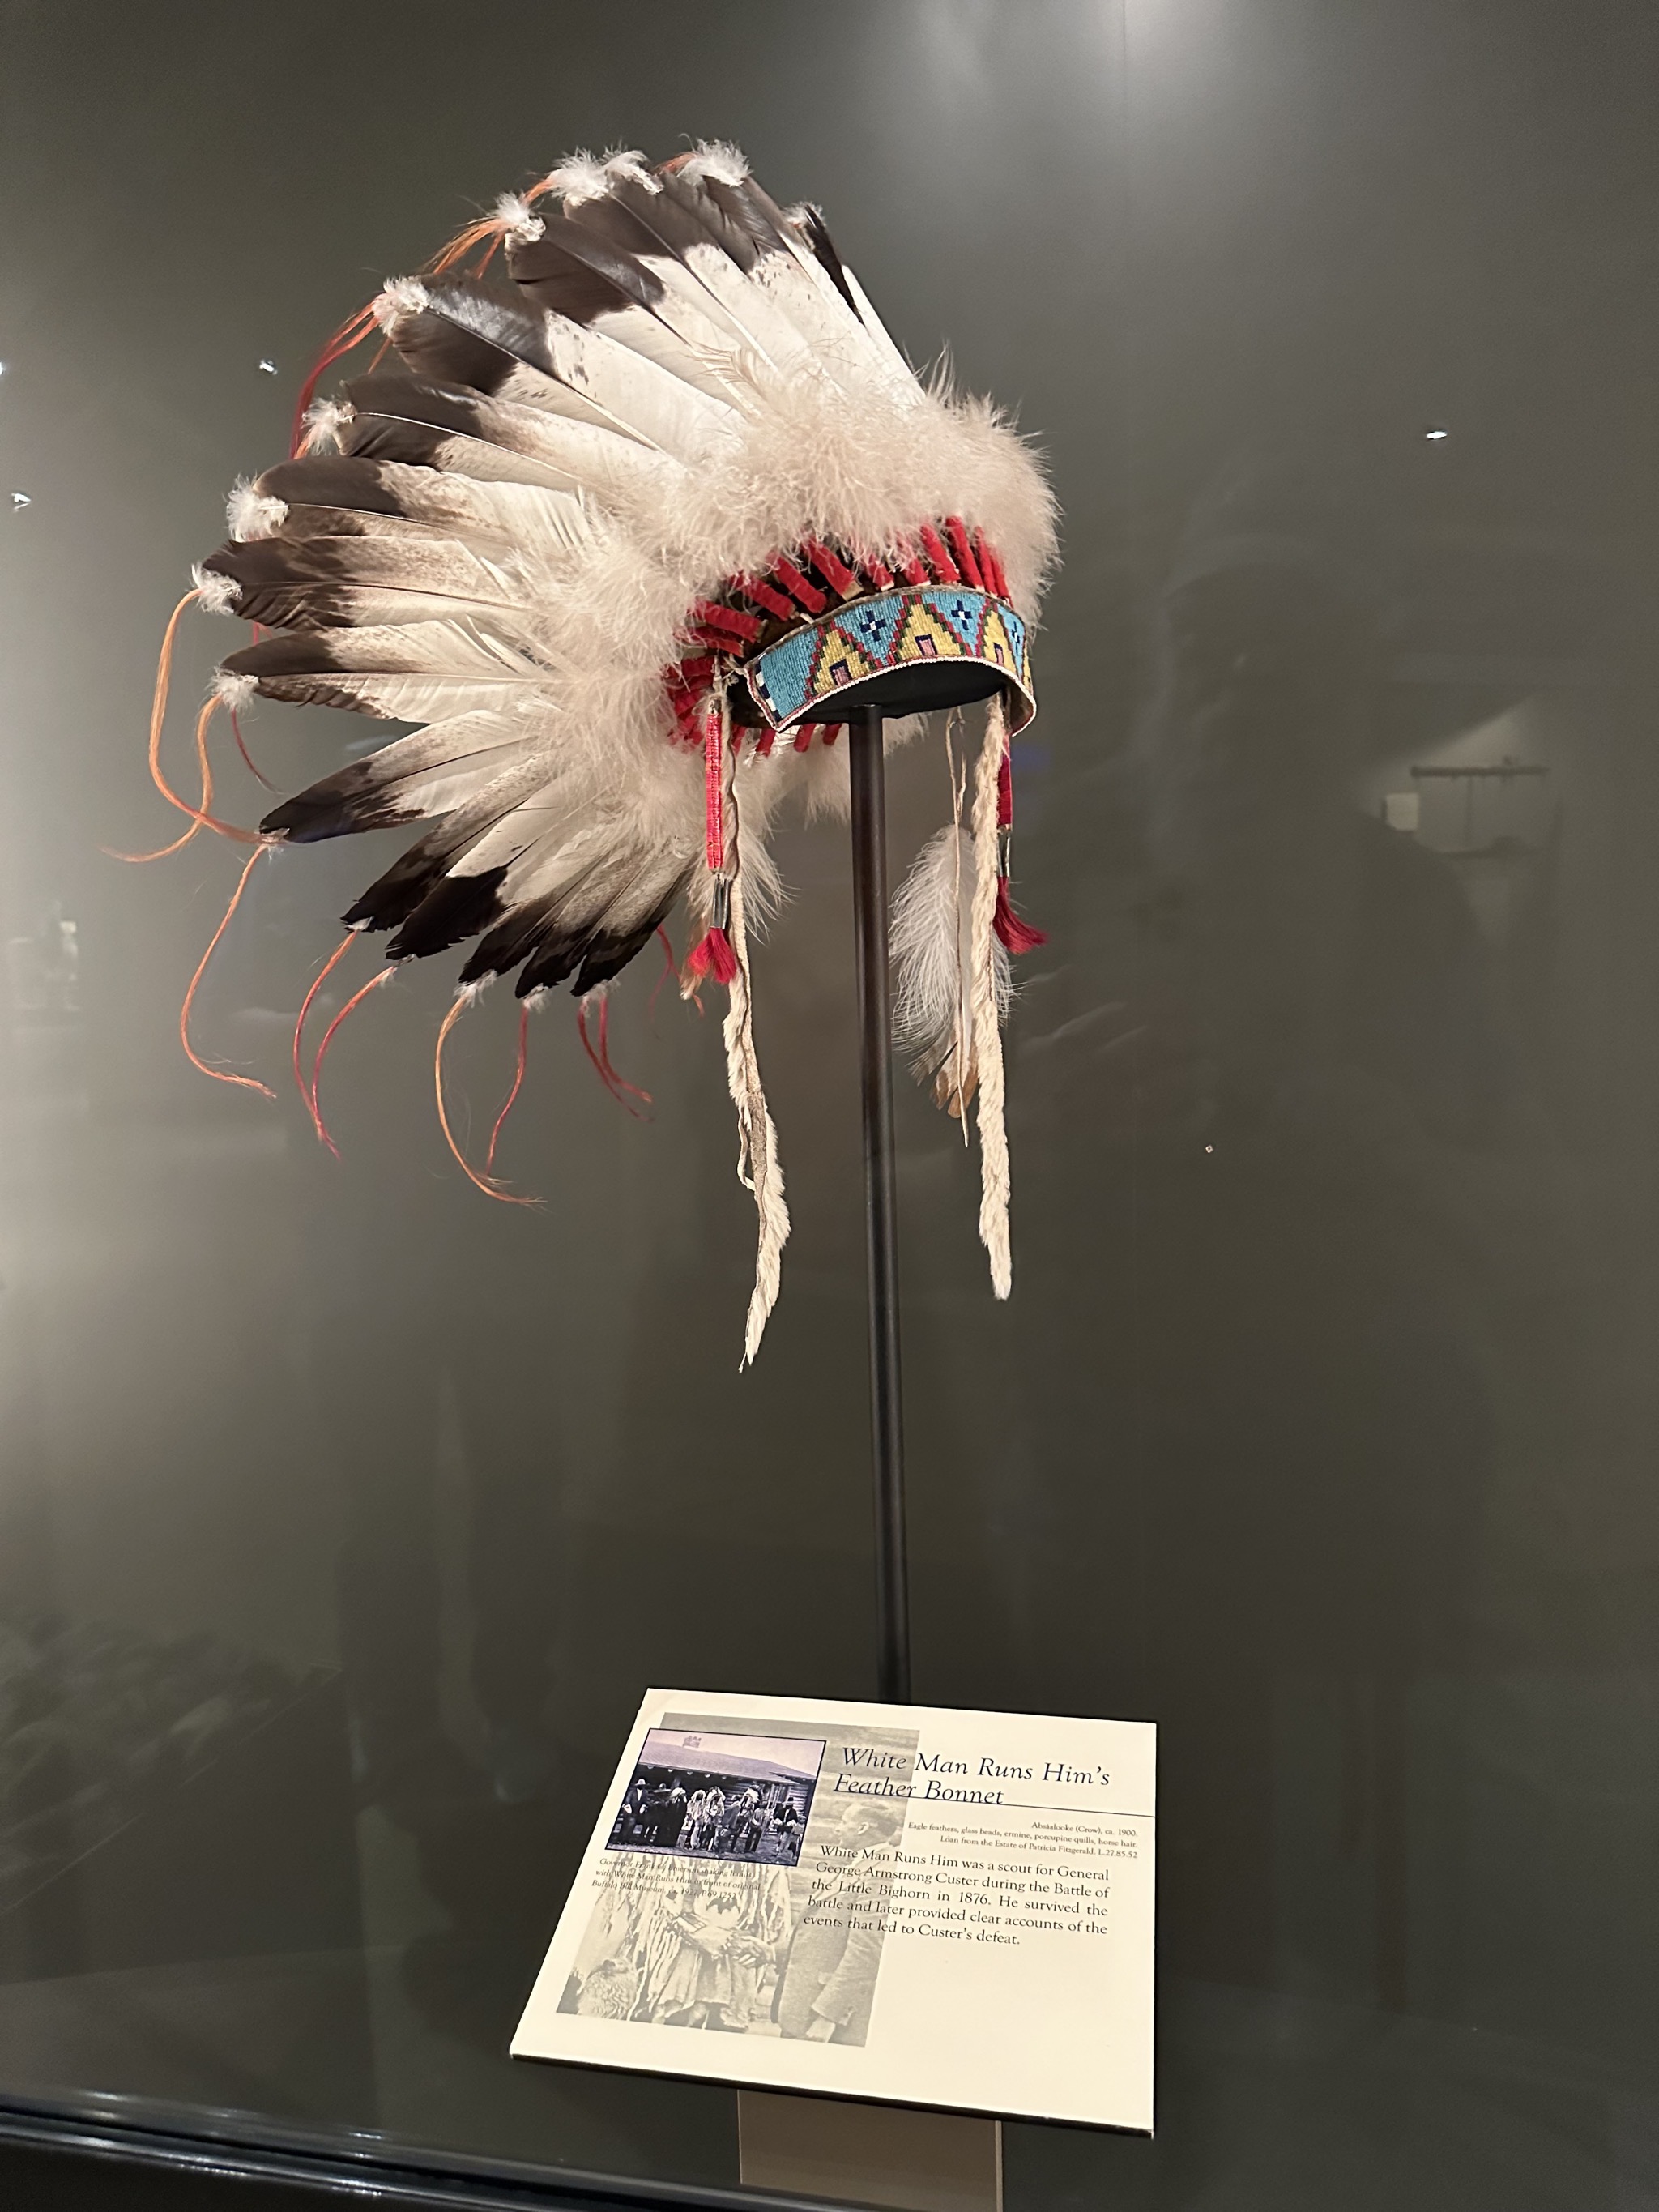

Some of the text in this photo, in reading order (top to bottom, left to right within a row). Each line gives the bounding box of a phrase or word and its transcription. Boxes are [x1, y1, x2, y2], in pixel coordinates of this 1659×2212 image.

[842, 1747, 1110, 1786] White Man Runs Him's
[834, 1773, 1004, 1804] Feather Bonnet
[908, 1821, 928, 1830] Eagle
[929, 1823, 959, 1834] feathers,
[961, 1826, 978, 1834] glass
[979, 1828, 1002, 1837] beads,
[1034, 1834, 1073, 1843] porcupine
[1073, 1836, 1096, 1845] quills,
[1098, 1838, 1119, 1846] horse
[1121, 1839, 1137, 1847] hair.
[1075, 1825, 1102, 1835] (Crow),
[940, 1835, 959, 1843] Loan
[961, 1837, 979, 1845] from
[980, 1838, 993, 1847] the
[995, 1839, 1017, 1848] Estate
[1029, 1843, 1056, 1851] Patricia
[1058, 1845, 1096, 1855] Fitzgerald.
[599, 1858, 633, 1867] Governor
[821, 1845, 1109, 1881] White Man Runs Him was a scout for General
[591, 1879, 617, 1889] Buffalo
[595, 1869, 612, 1877] with
[614, 1870, 636, 1879] White
[637, 1873, 654, 1881] Man
[655, 1874, 674, 1882] Runs
[703, 1879, 722, 1887] front
[732, 1883, 761, 1891] original
[816, 1861, 1111, 1898] George Armstrong Custer during the Battle of
[812, 1878, 1108, 1916] the Little Bighorn in 1876. He survived the
[808, 1895, 1108, 1934] battle and later provided clear accounts of the
[804, 1916, 1021, 1945] events that led to Custer's defeat.
